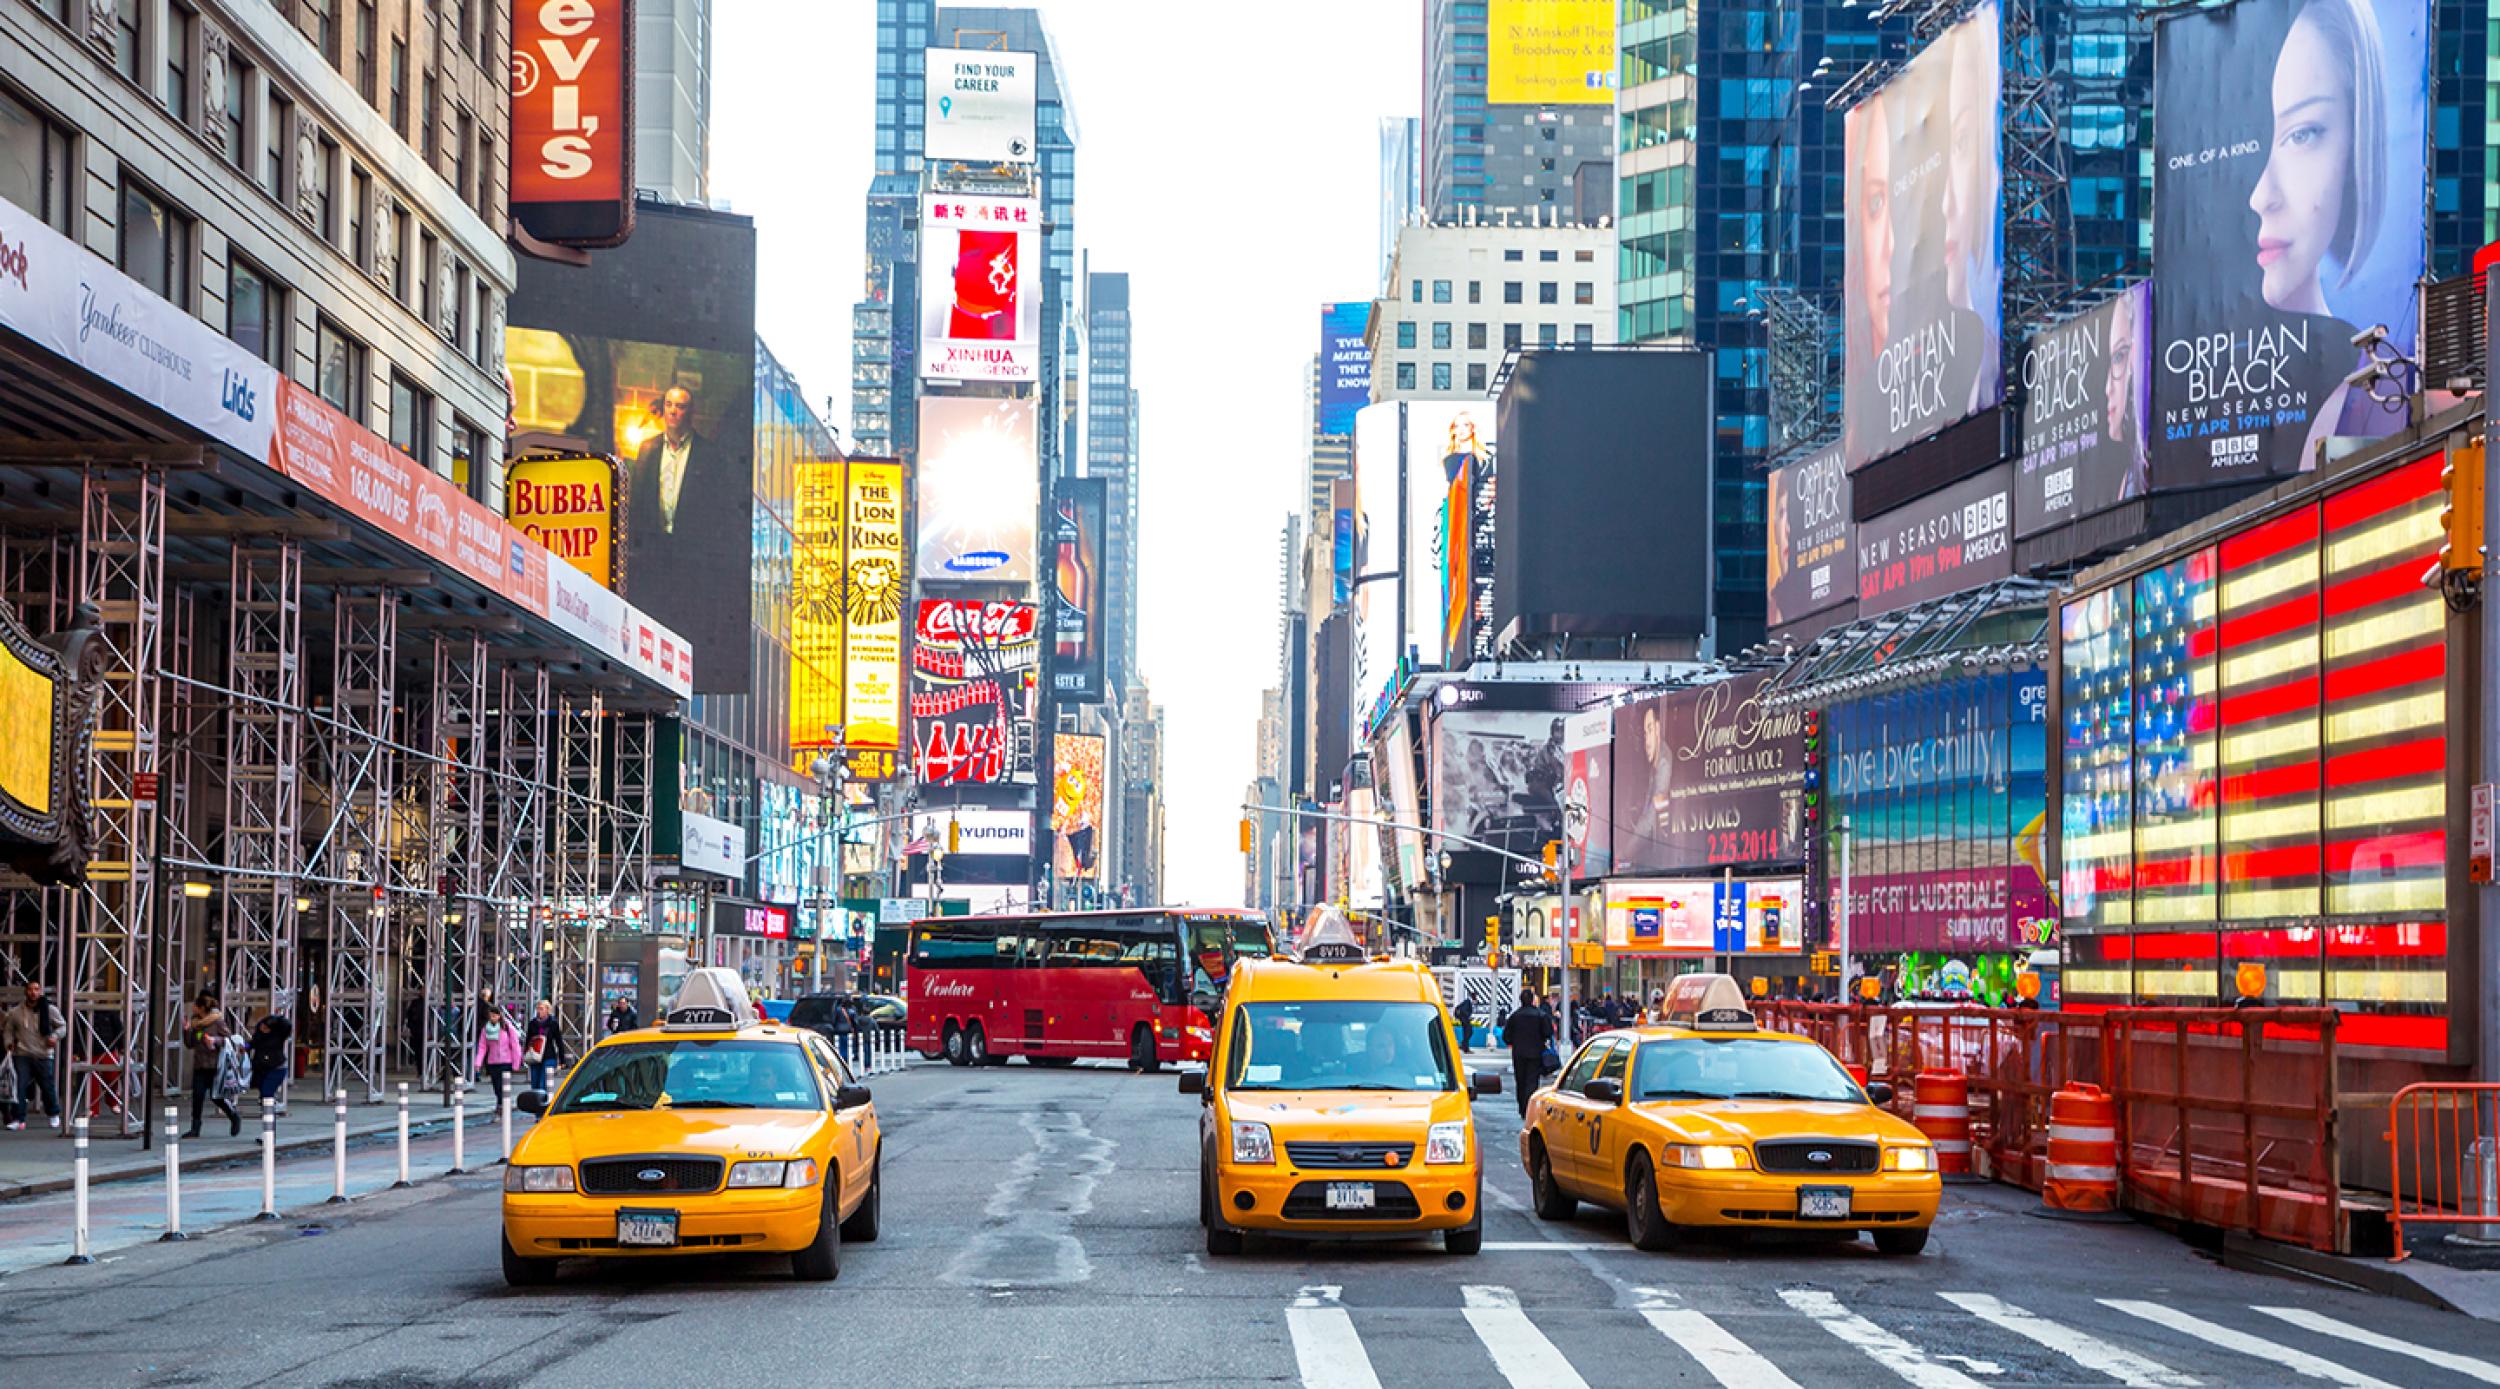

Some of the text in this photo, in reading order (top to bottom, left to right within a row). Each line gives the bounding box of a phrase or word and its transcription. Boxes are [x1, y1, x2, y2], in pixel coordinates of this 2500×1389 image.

[1513, 44, 1578, 58] Broadway
[954, 63, 1015, 78] FIND YOUR
[954, 78, 999, 92] CAREER
[2199, 148, 2216, 164] OF
[2219, 146, 2229, 159] A
[934, 203, 1029, 223] 新华讯社
[0, 230, 28, 291] ock
[80, 281, 192, 383] Yankees CLUBHOUSE
[2165, 319, 2308, 374] ORPHAN
[947, 348, 1014, 364] XINHUA
[1878, 311, 1956, 394] ORPHAN
[2022, 318, 2100, 390] ORPHAN
[221, 367, 256, 423] Lids
[2034, 362, 2089, 425] BLACK
[2189, 354, 2291, 403] BLACK
[1890, 362, 1946, 433] BLACK
[2166, 391, 2308, 425] NEW SEASON
[2023, 409, 2098, 454] NEW SEASON
[2166, 409, 2307, 441] SAT APR 19TH 9PM
[2023, 453, 2038, 475] SAT
[2039, 447, 2057, 469] APR
[2211, 433, 2260, 457] BBC
[2211, 451, 2260, 468] AMERICA
[351, 465, 391, 518] 168,000
[860, 486, 890, 499] THE
[1797, 451, 1846, 501] ORPHAN
[2044, 467, 2074, 498] BBC
[514, 478, 606, 516] BUBBA
[854, 501, 896, 521] LION
[1804, 481, 1840, 529] BLACK
[851, 525, 899, 550] KING
[1860, 491, 2008, 570] NEW SEASON BBC
[1861, 530, 2008, 600] SAT APR 19TH 9PM AMERICA
[1704, 752, 1754, 779] FORMULA
[1838, 731, 1876, 802] bye
[1883, 723, 1924, 798] bye
[1707, 828, 1778, 865] 2.25.2014
[1872, 886, 1906, 914] FORT
[1908, 879, 2006, 912] LAUDERDALE
[1946, 912, 2007, 943] sunny.org
[922, 973, 975, 998] Venture
[684, 1009, 715, 1024] 2Y77
